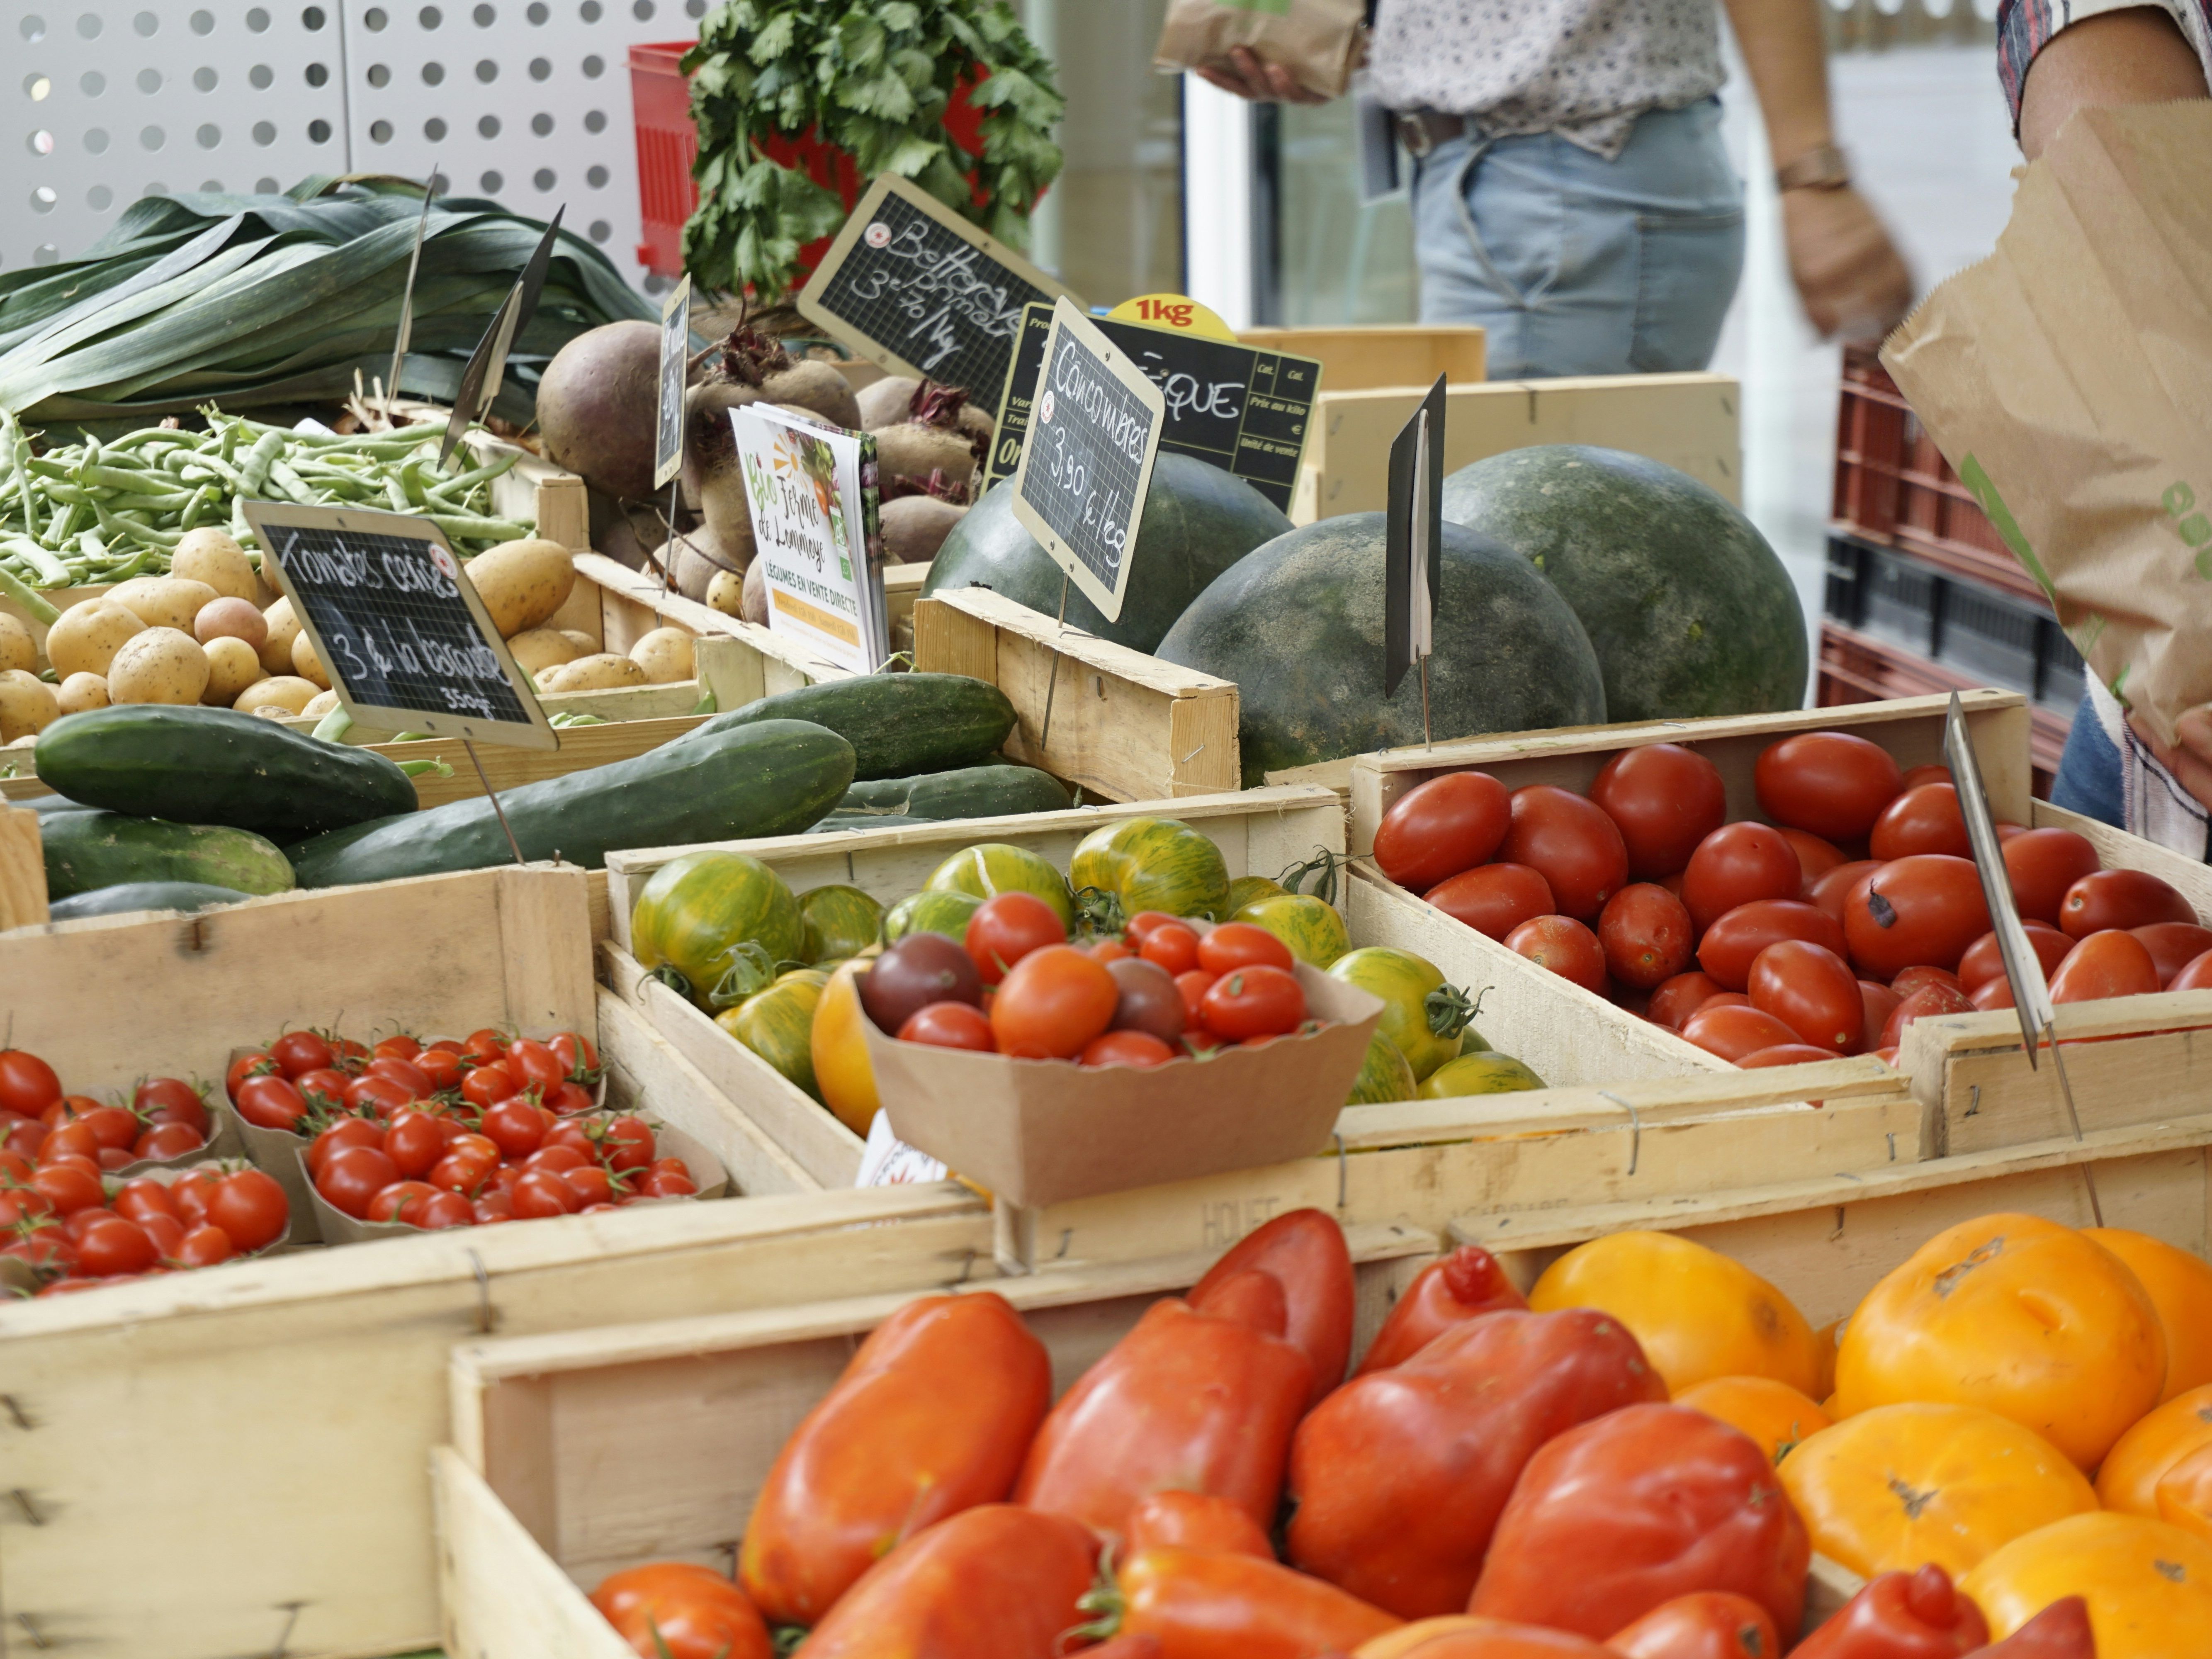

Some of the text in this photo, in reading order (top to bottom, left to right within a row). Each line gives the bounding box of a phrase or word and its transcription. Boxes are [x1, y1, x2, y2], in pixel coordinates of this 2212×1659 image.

[1136, 299, 1194, 327] 1kg
[1008, 414, 1028, 426] Trai
[1056, 341, 1147, 464] Concombres
[1249, 397, 1270, 409] Prix
[1271, 403, 1285, 411] au
[999, 438, 1022, 465] Or
[1240, 438, 1298, 457] Unité de vente
[745, 452, 819, 529] Bio Ferme
[280, 531, 384, 589] Tomates
[759, 509, 825, 573] de Lommoye
[766, 559, 796, 588] LÉGUMES
[797, 575, 807, 593] EN
[807, 579, 829, 603] VENTE
[829, 589, 857, 617] DIRECTE
[333, 633, 368, 680] 3
[381, 617, 428, 677] la
